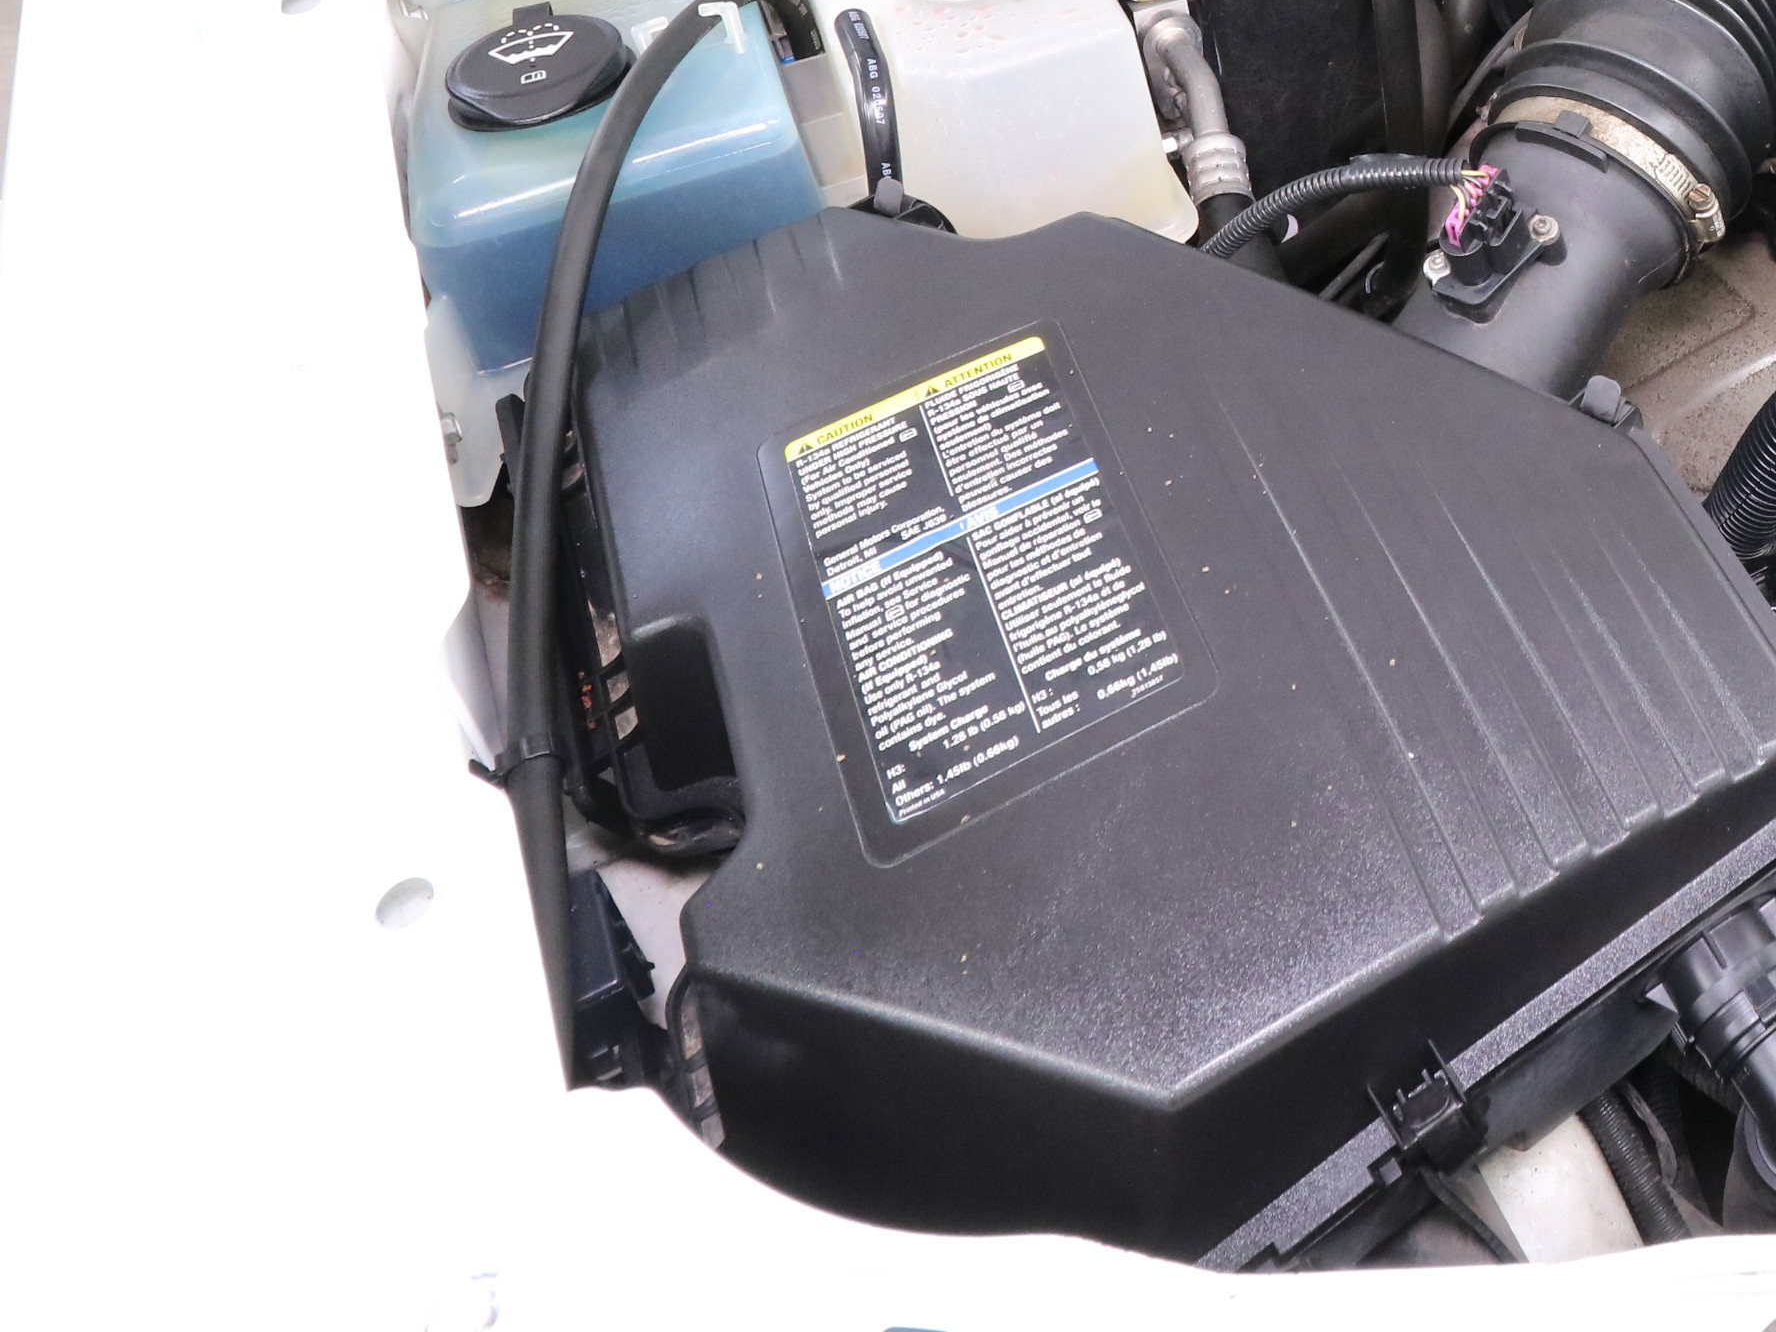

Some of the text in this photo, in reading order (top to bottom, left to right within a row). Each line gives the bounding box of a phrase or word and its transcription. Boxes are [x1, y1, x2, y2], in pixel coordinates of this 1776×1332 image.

[866, 58, 879, 79] ABG
[880, 162, 892, 179] AB
[945, 353, 1012, 387] ATTENTION
[817, 412, 872, 442] CAUTION
[831, 416, 894, 451] REFRIGERANT
[858, 420, 907, 448] PRESSURE
[837, 436, 894, 467] Conditioned
[805, 481, 840, 502] System
[867, 450, 906, 473] serviced
[821, 480, 862, 504] qualified
[863, 458, 909, 486] personnel
[878, 468, 912, 488] service
[812, 480, 906, 528] methods may cause
[965, 505, 999, 529] AVIS
[815, 512, 856, 538] personal
[900, 524, 921, 540] SAE
[823, 543, 858, 566] General
[858, 529, 890, 549] Motors
[828, 559, 882, 594] NOTICE
[852, 596, 875, 612] help
[876, 581, 903, 600] avoid
[904, 557, 952, 586] unwanted
[836, 593, 855, 609] AIR
[855, 582, 878, 599] BAG
[845, 573, 970, 640] Manual for diagnostic
[884, 595, 901, 608] see
[902, 577, 937, 599] Service
[848, 587, 965, 650] and service procedures
[851, 611, 941, 660] before performing
[854, 656, 873, 671] any
[858, 628, 953, 682] AIR CONDITIONING
[1044, 657, 1082, 681] Charge
[1083, 649, 1098, 662] du
[1110, 651, 1126, 663] kg
[863, 661, 940, 704] Use only R-134a
[867, 672, 940, 715] refrigerant and
[935, 670, 967, 693] Glycol
[874, 725, 888, 739] oil
[937, 691, 956, 706] The
[958, 672, 995, 696] system
[1035, 690, 1078, 716] Tous les
[1041, 706, 1074, 728] autres
[878, 722, 923, 750] contains
[908, 704, 988, 751] System Charge
[942, 730, 966, 748] 1.28
[966, 725, 978, 736] lb
[892, 779, 906, 794] All
[930, 788, 945, 800] USA
